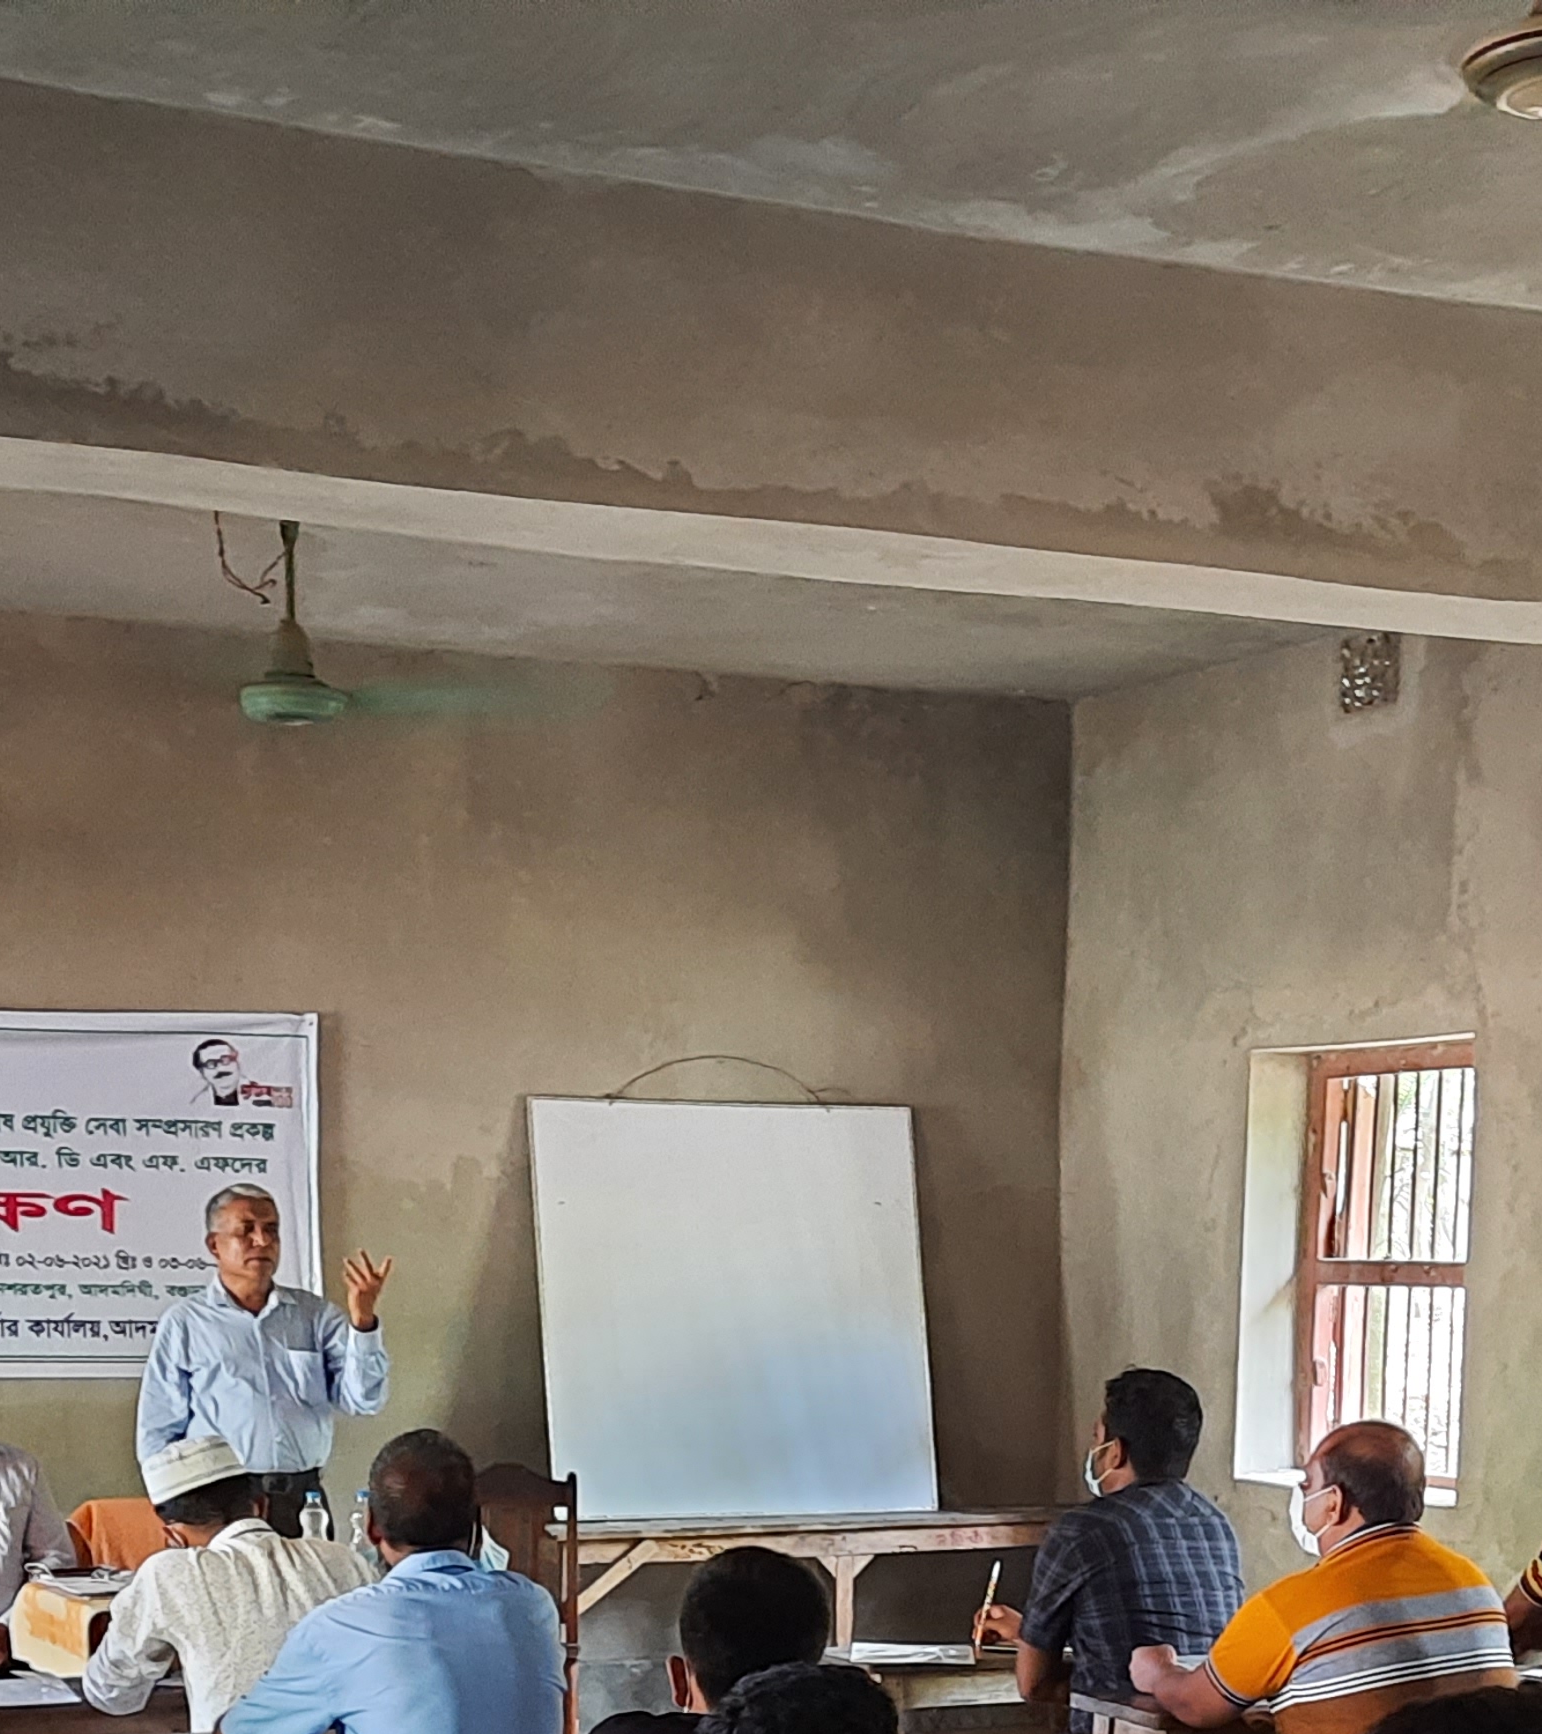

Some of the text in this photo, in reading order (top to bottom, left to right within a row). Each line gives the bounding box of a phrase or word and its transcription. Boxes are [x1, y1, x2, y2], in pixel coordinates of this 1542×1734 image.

[21, 1109, 78, 1138] প্রযুক্তি
[85, 1117, 127, 1137] সেবা
[229, 1121, 276, 1141] প্রকল্প
[56, 1147, 80, 1169] ডি
[90, 1153, 137, 1172] এবং
[142, 1154, 186, 1173] এফ.
[194, 1156, 268, 1174] এফদের
